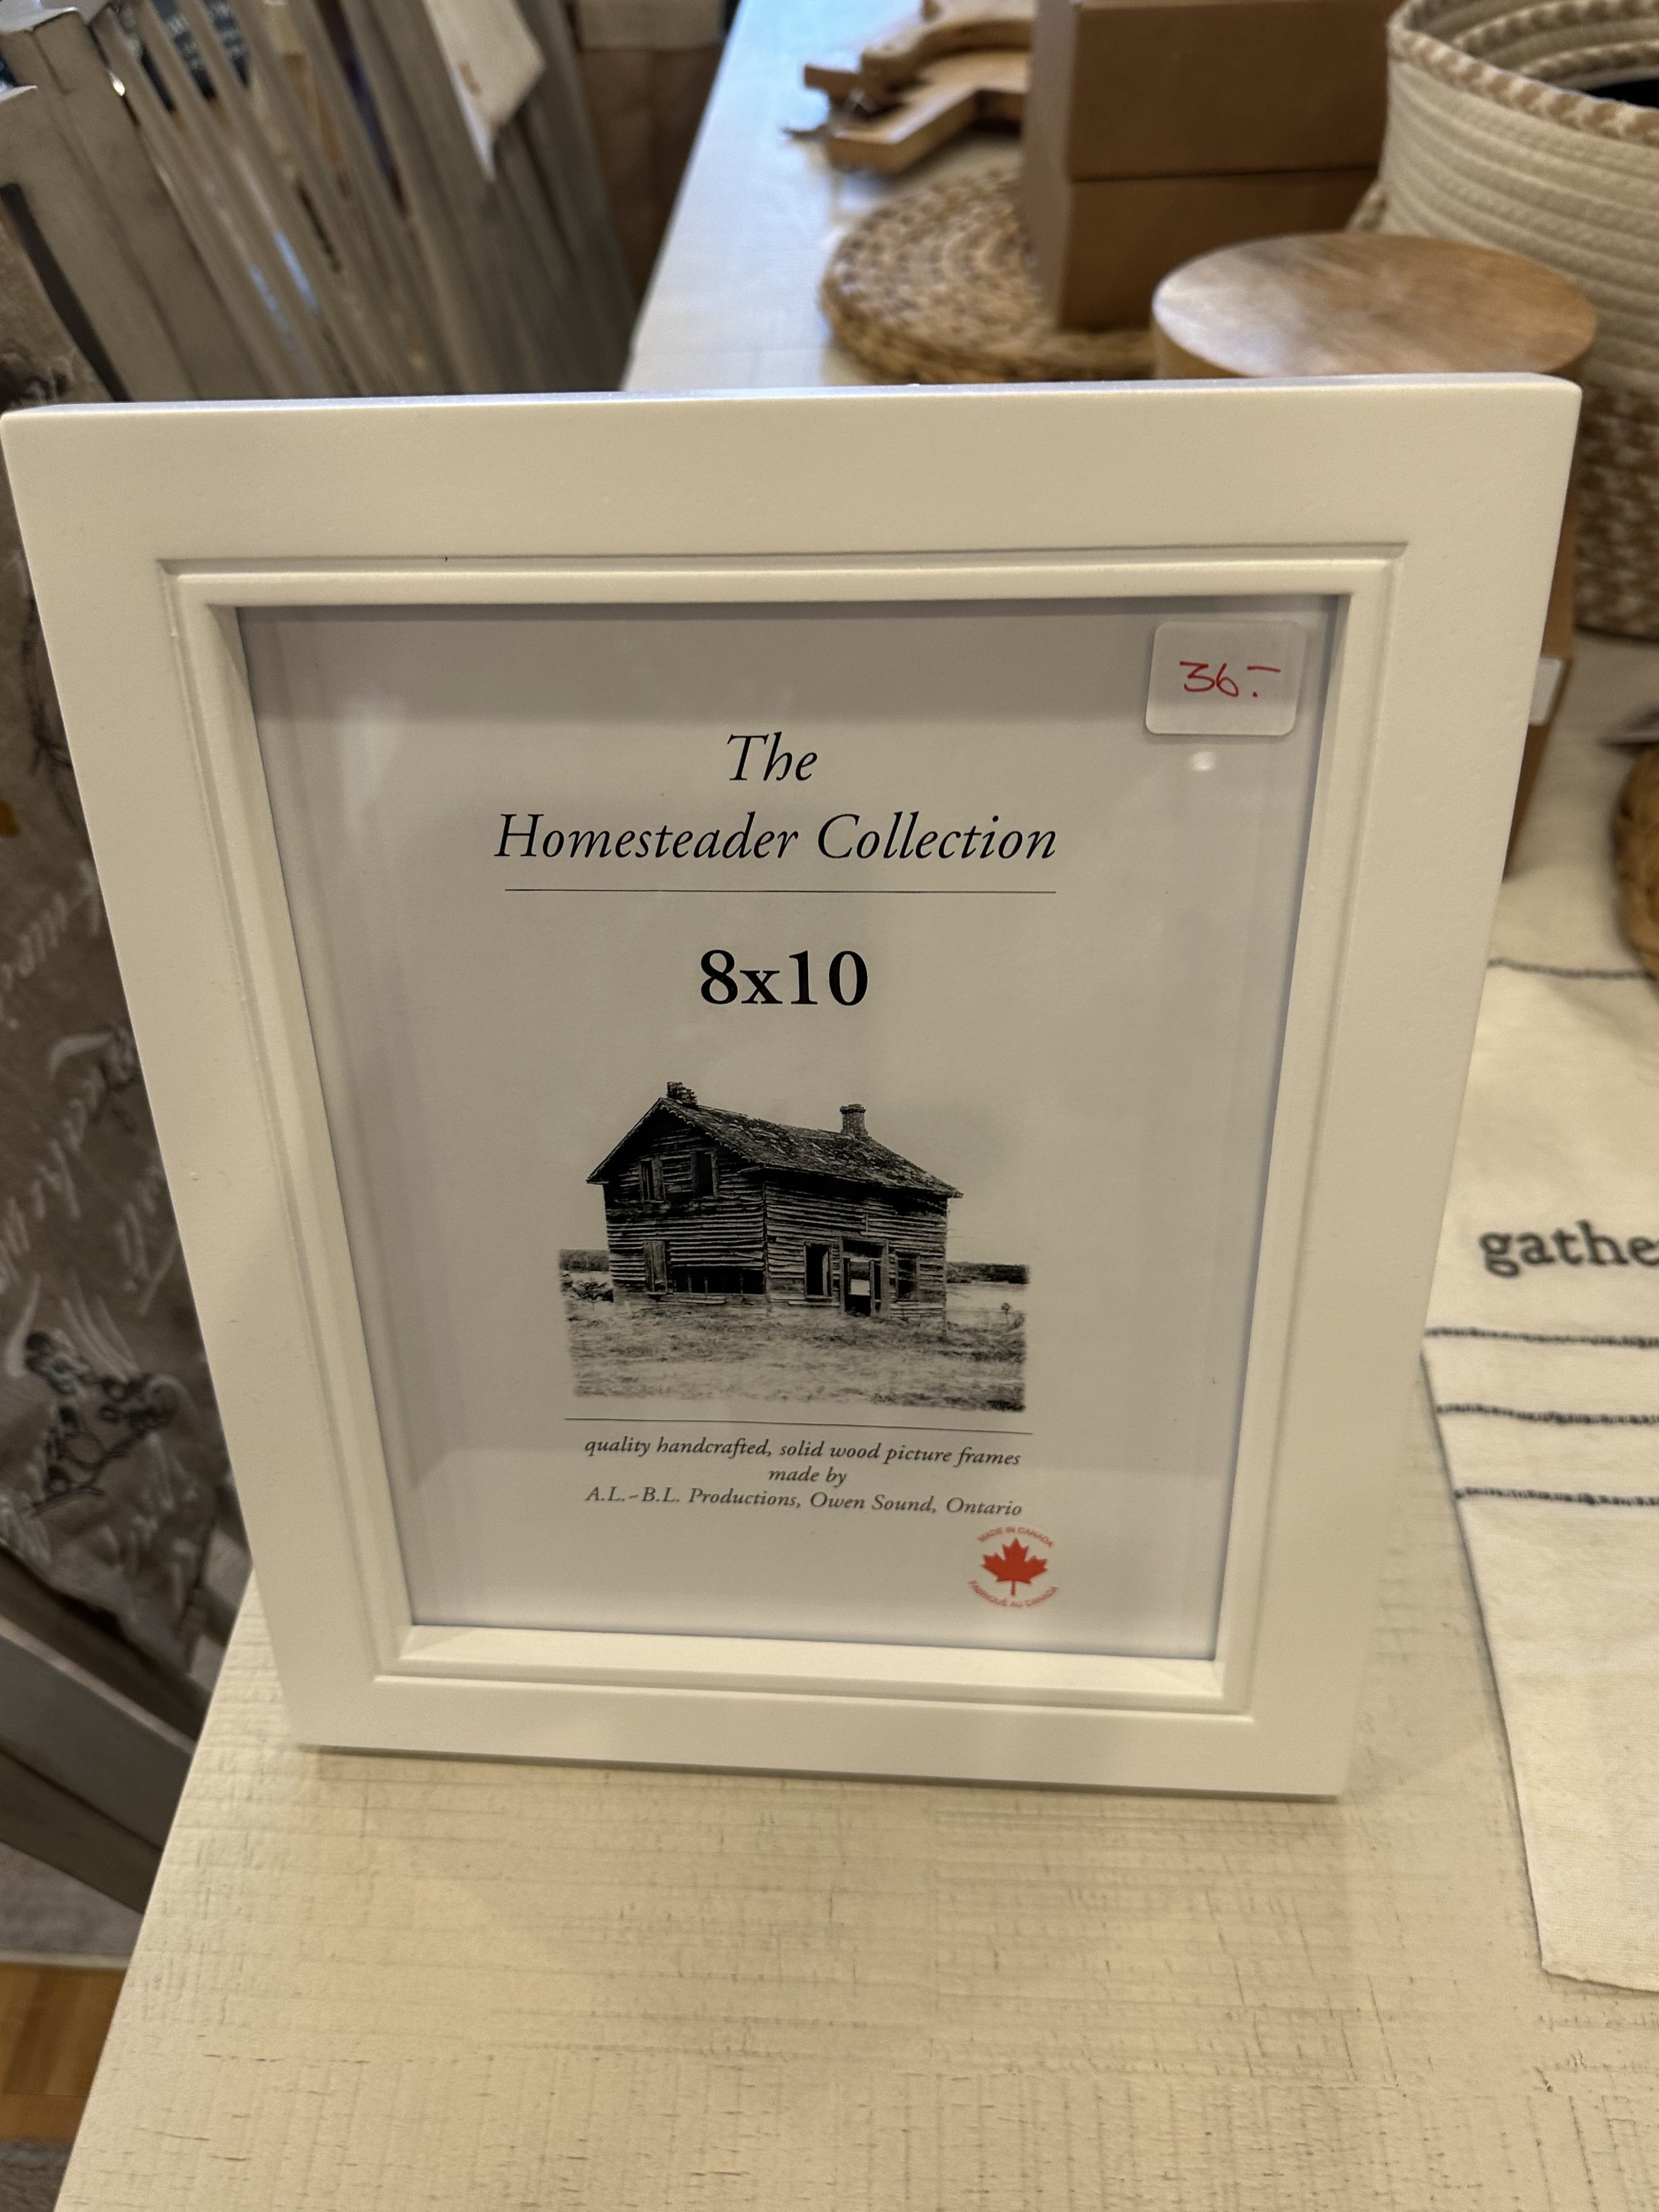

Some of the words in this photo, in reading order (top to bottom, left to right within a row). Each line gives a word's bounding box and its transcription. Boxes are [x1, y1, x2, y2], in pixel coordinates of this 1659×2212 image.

[727, 731, 817, 781] The
[494, 811, 798, 859] Homesteader
[818, 811, 1056, 859] Collection
[701, 950, 867, 1006] 8x10
[585, 1436, 651, 1457] quality
[657, 1436, 771, 1459] handcrafted,
[780, 1440, 825, 1457] solid
[830, 1443, 881, 1458] wood
[883, 1445, 952, 1464] picture
[954, 1447, 1021, 1467] frames
[769, 1466, 820, 1482] made
[826, 1466, 847, 1488] by
[688, 1488, 800, 1508] Productions,
[810, 1492, 865, 1509] Owen
[872, 1494, 936, 1513] Sound,
[946, 1497, 1022, 1515] Ontario
[1017, 1527, 1053, 1547] CANADA
